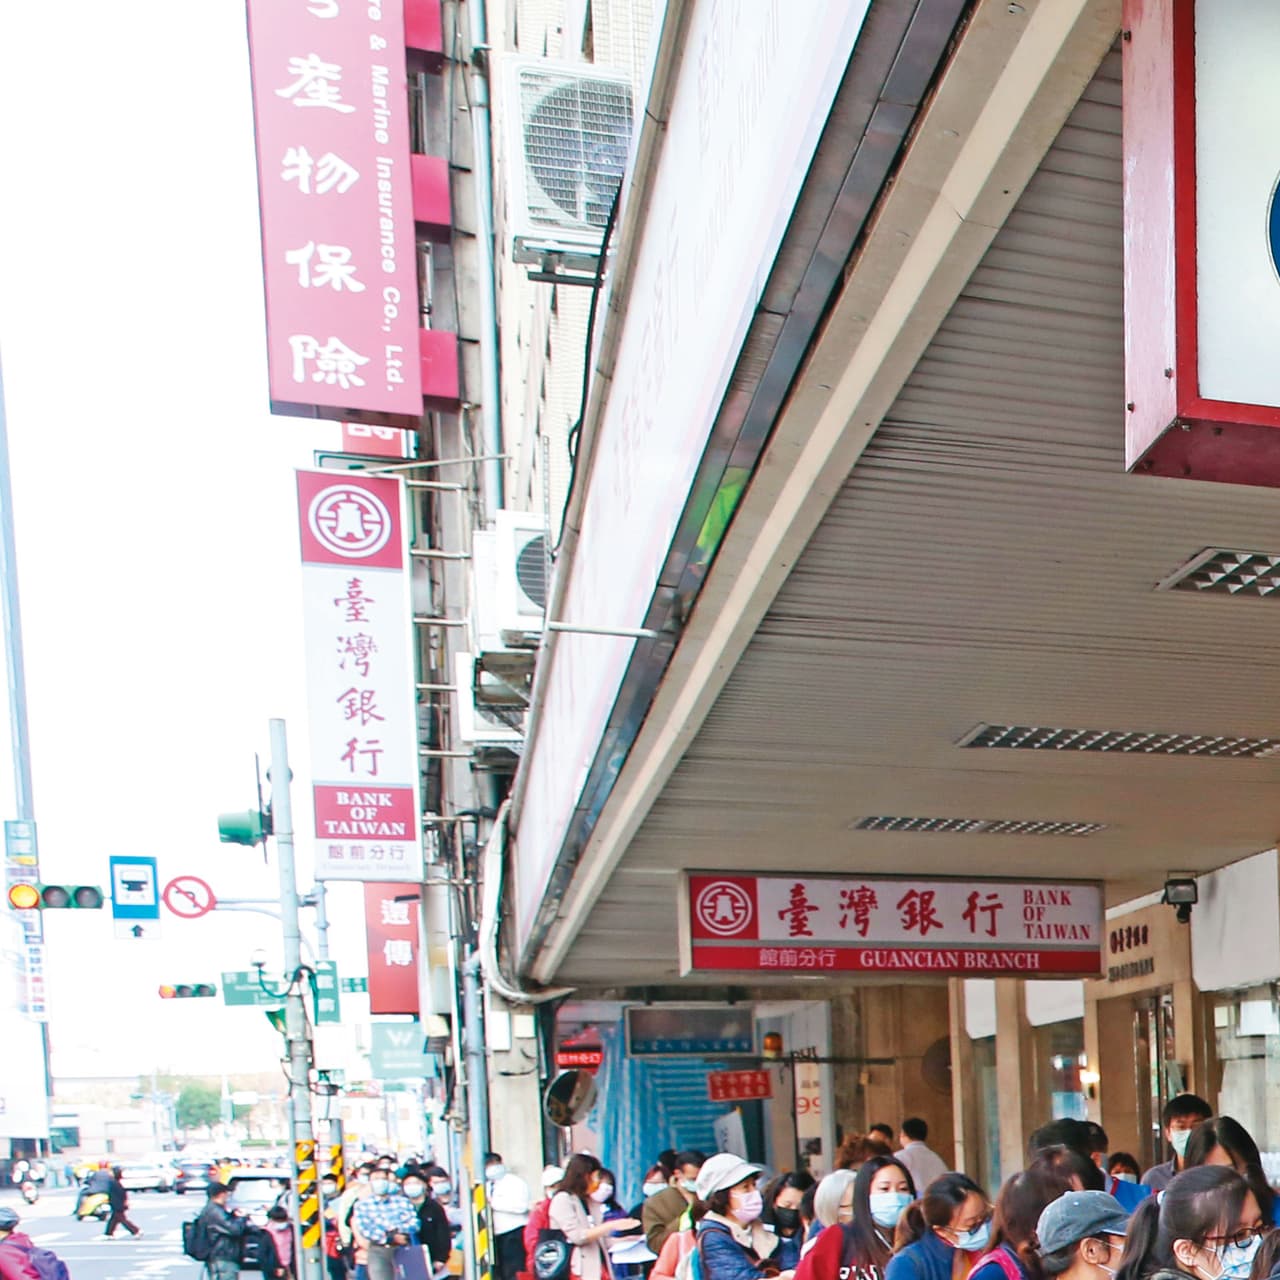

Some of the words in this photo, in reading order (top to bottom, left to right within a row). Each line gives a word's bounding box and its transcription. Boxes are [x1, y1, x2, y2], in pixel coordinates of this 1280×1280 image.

[370, 34, 387, 51] &
[371, 65, 391, 144] Marine
[375, 156, 397, 273] Insurance
[382, 286, 400, 333] Co.,
[384, 344, 404, 392] Ltd.
[334, 577, 385, 777] 臺灣銀行
[336, 791, 393, 808] BANK
[350, 807, 377, 821] OF
[324, 820, 405, 837] TAIWAN
[1023, 888, 1073, 906] BANK
[777, 883, 1004, 938] 臺灣銀行
[1023, 906, 1046, 922] OF
[1023, 923, 1092, 941] TAIWAN
[759, 948, 836, 967] 館前分行
[860, 951, 961, 969] GUANCIAN
[964, 952, 1040, 969] BRANCH
